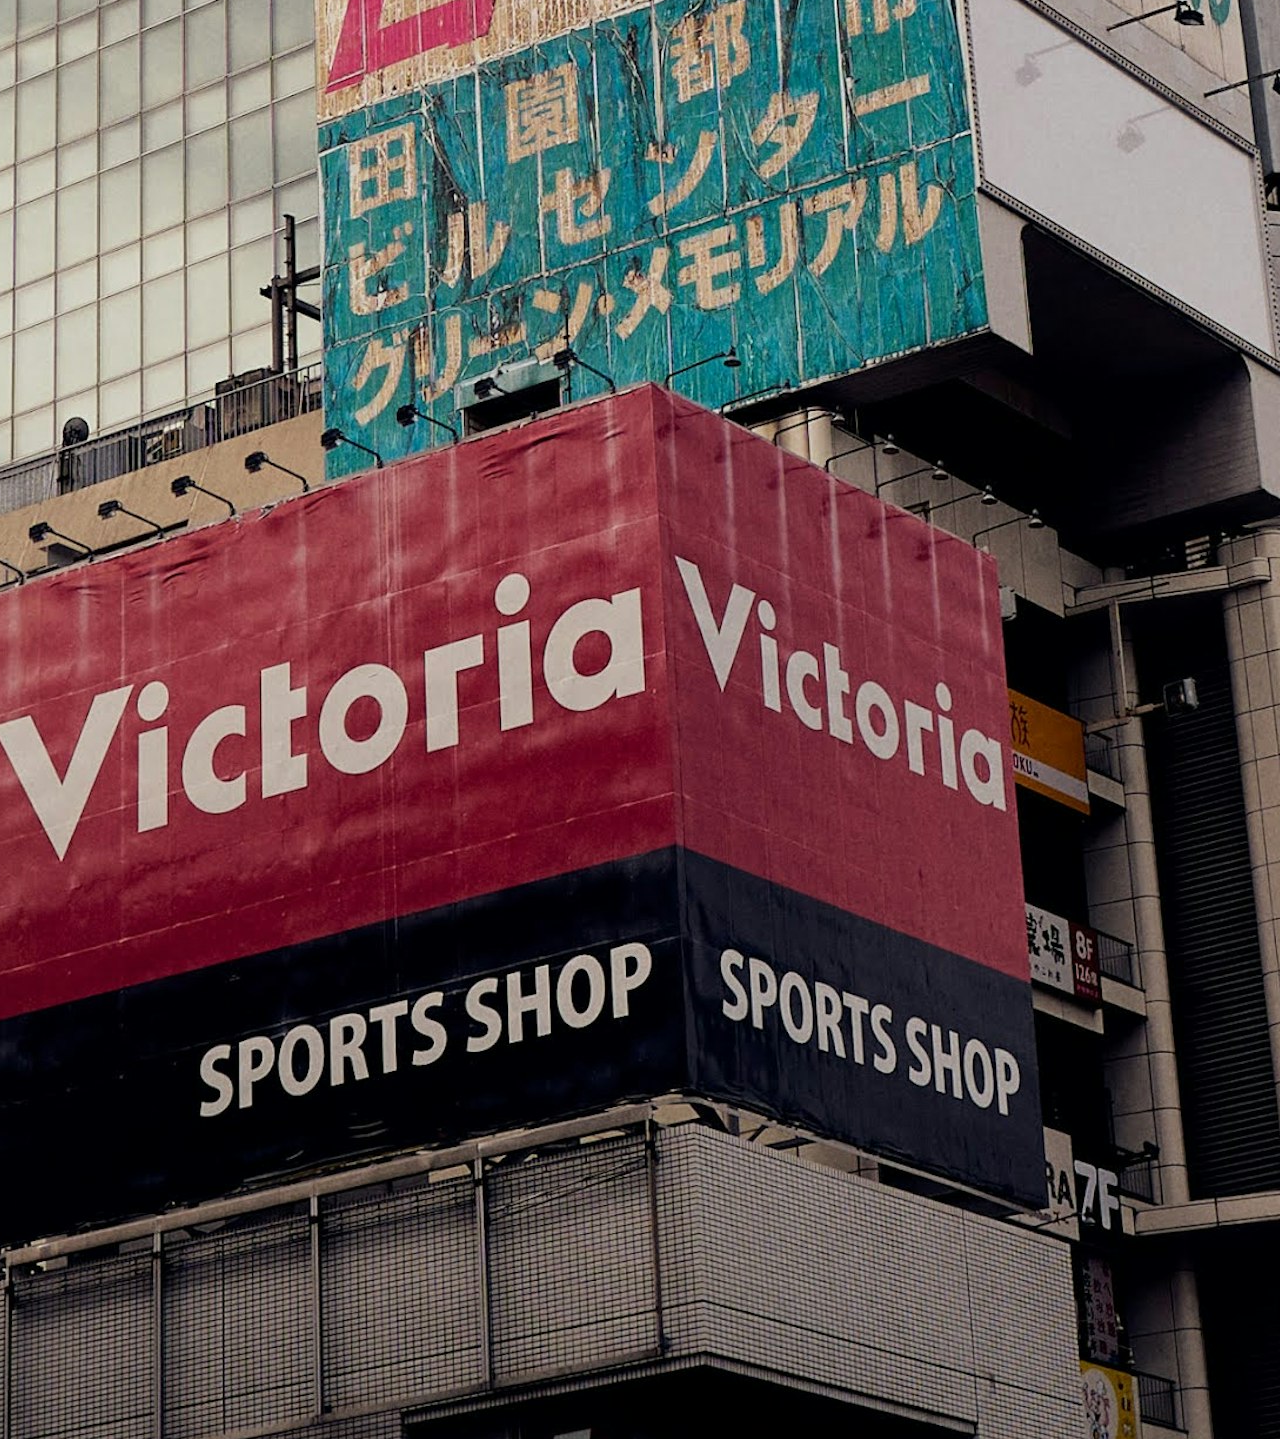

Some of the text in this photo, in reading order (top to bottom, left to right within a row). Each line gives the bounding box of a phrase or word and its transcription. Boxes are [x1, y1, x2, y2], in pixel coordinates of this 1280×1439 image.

[348, 73, 932, 316] ビルセンター
[673, 554, 1008, 813] Victoria
[198, 940, 655, 1118] SPORTS SHOP
[718, 947, 1022, 1118] SPORTS SHOP
[1074, 930, 1095, 962] 8F
[1073, 1158, 1120, 1232] 7F
